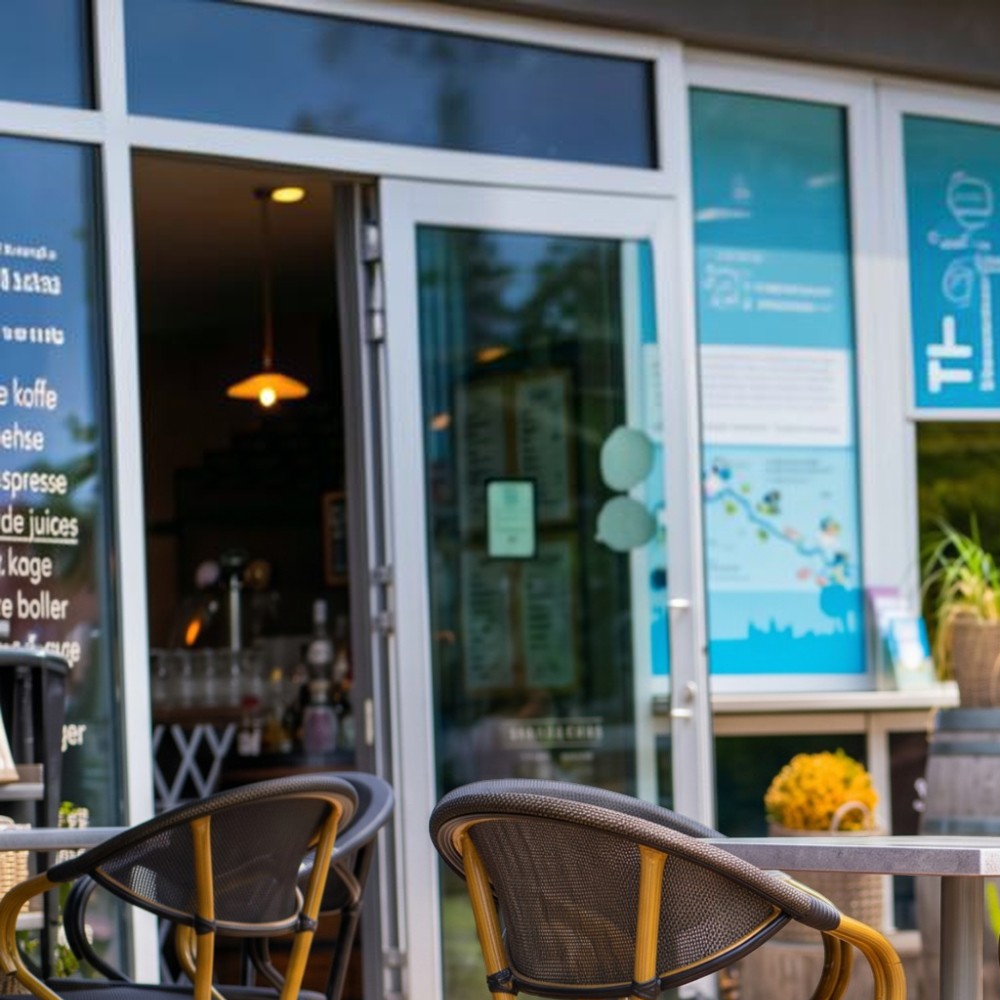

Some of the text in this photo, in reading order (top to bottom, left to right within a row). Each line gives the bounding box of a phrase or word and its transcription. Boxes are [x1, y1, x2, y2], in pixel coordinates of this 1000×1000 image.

[12, 376, 58, 411] koffe
[28, 508, 79, 542] juices
[8, 546, 53, 586] kage
[17, 590, 69, 620] boller
